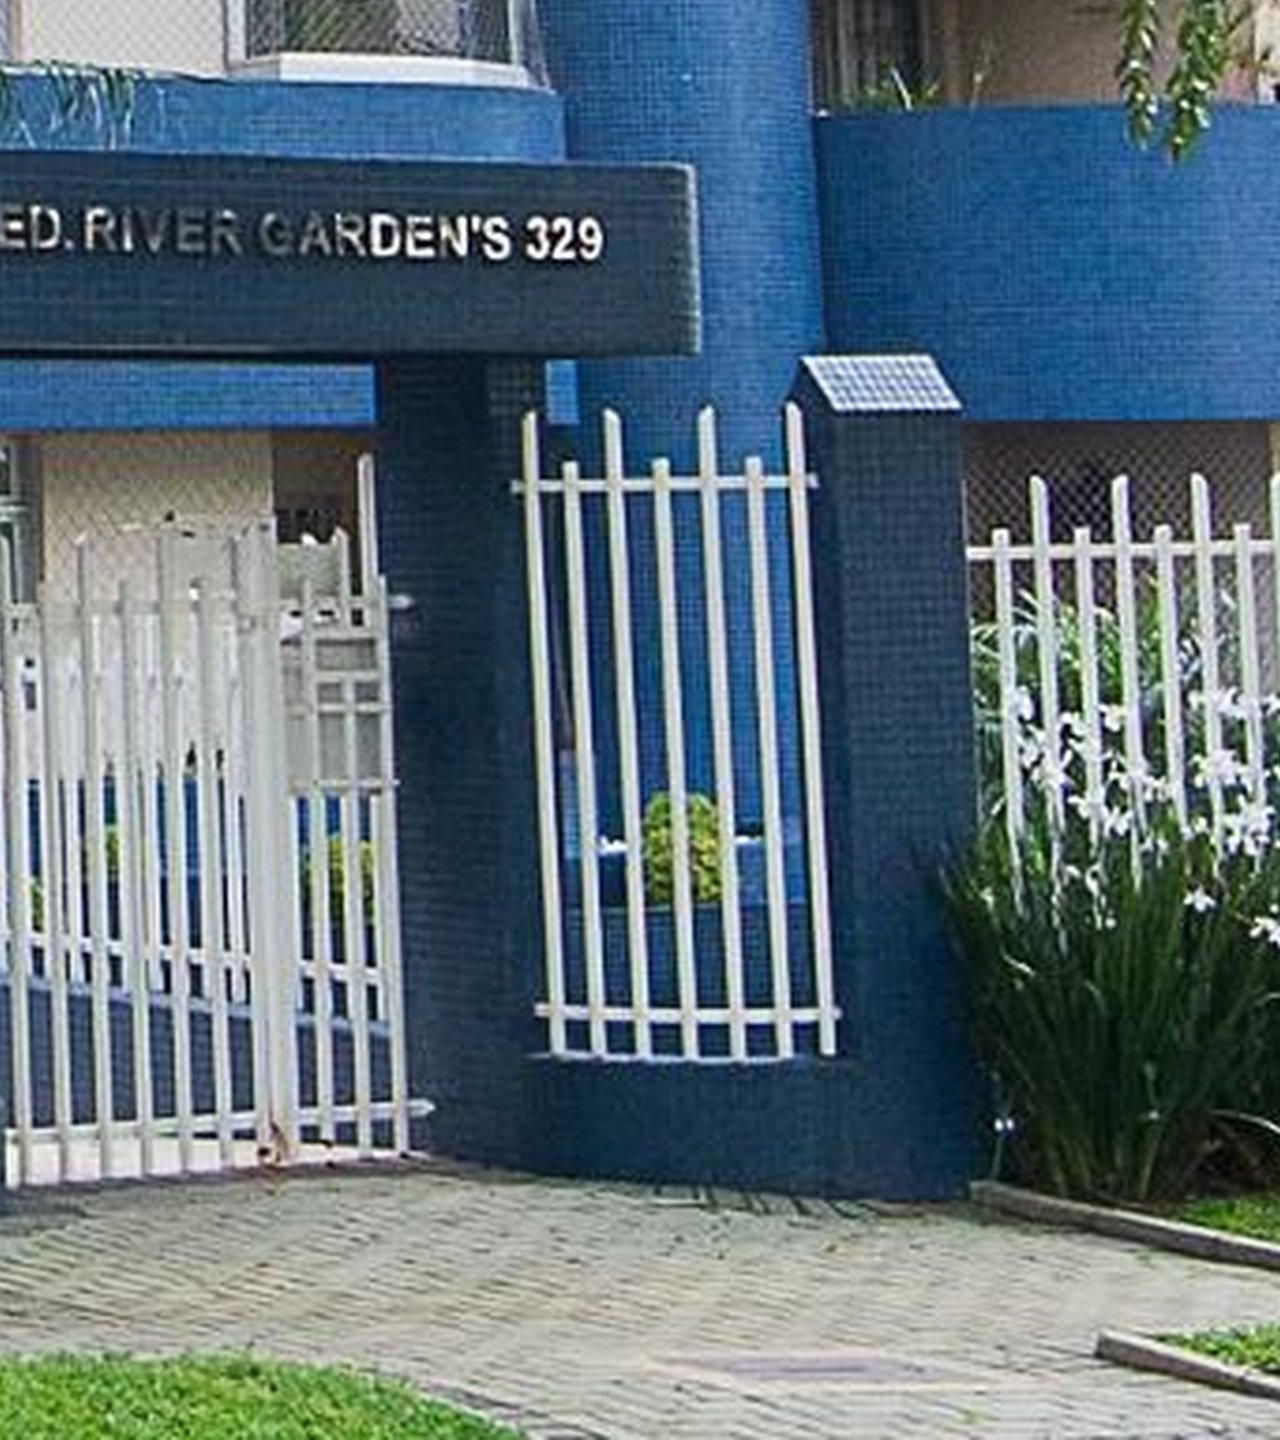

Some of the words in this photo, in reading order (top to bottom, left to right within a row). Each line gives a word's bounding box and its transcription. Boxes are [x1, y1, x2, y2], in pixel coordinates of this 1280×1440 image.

[85, 205, 243, 256] RIVER
[259, 210, 512, 261] GARDEN'S
[524, 216, 605, 261] 329
